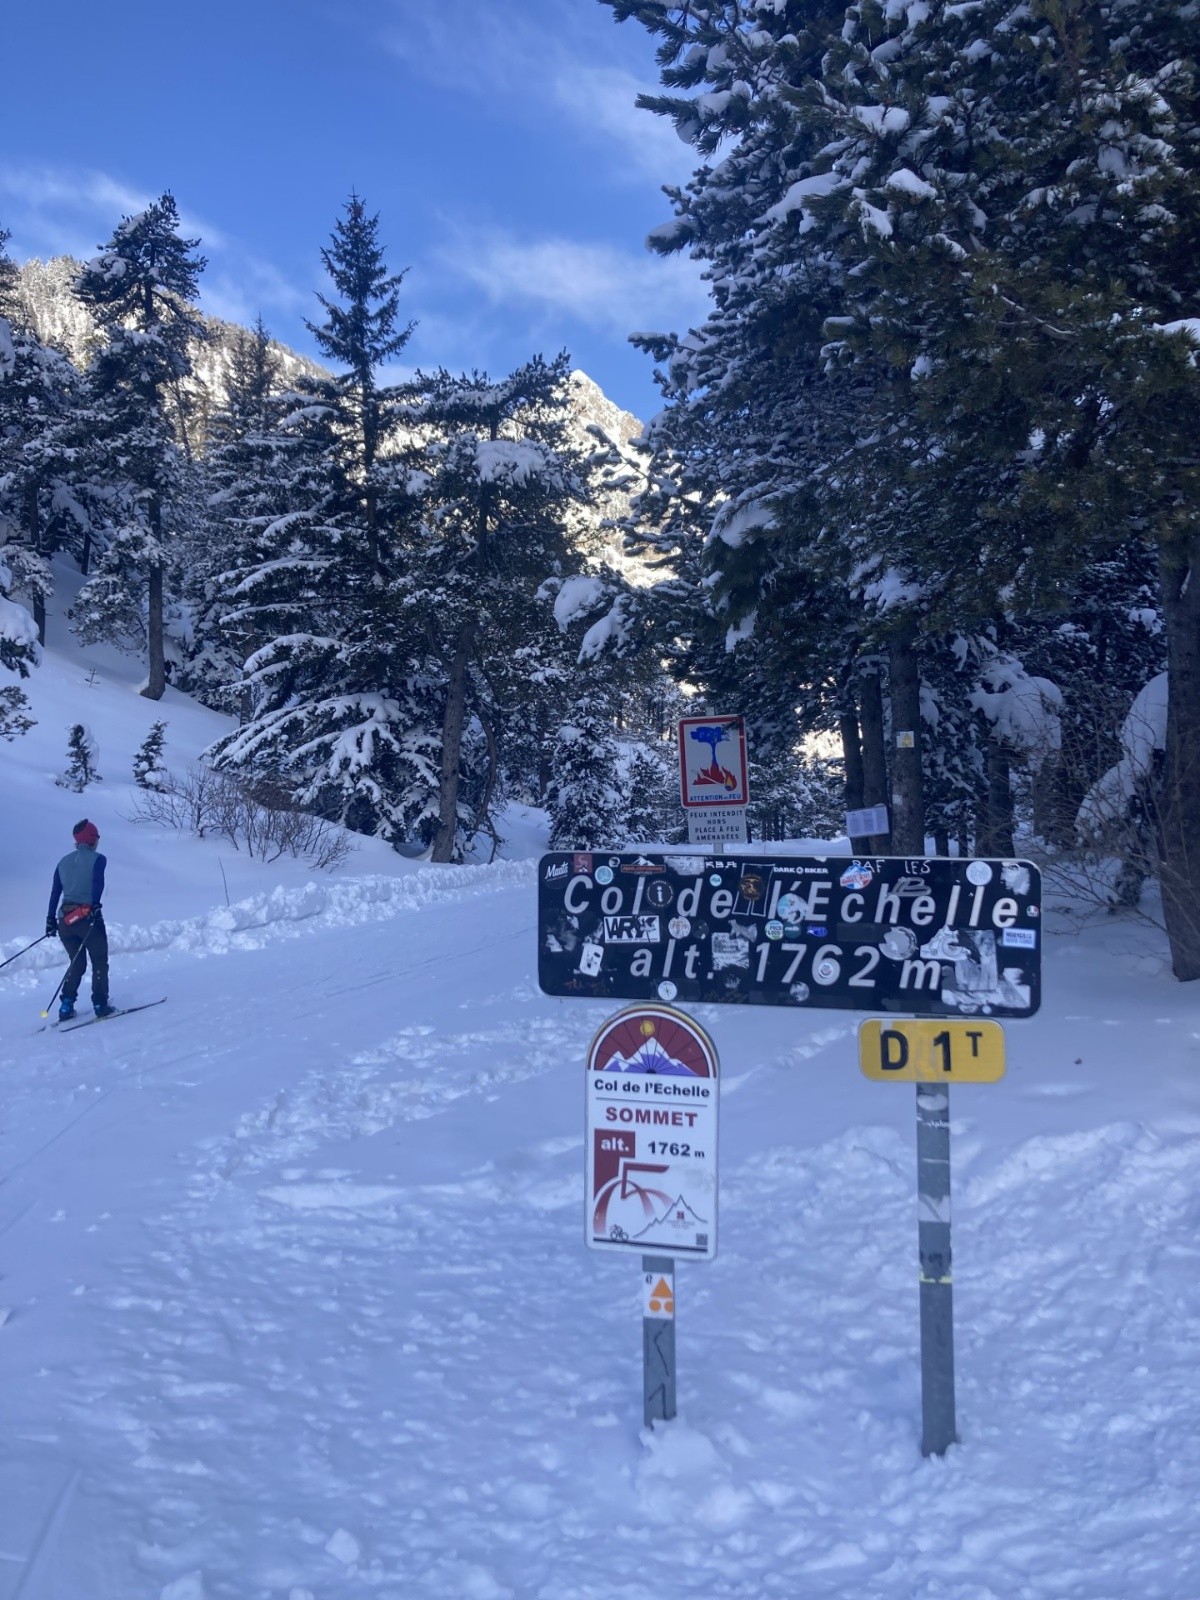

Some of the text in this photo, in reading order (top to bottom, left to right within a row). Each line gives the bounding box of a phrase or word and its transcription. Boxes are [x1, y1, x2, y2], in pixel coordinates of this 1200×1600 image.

[690, 794, 723, 802] ATTENTION
[695, 826, 716, 834] PLACE
[904, 859, 931, 875] LES
[563, 874, 646, 915] Col
[676, 877, 734, 919] de
[767, 879, 1019, 929] l'Echelle
[629, 938, 942, 991] alt. 1762 m
[880, 1029, 909, 1070] D
[594, 1079, 710, 1098] Col de l'Echelle
[605, 1106, 698, 1127] SOMMET
[601, 1136, 705, 1158] alt. 1762 m
